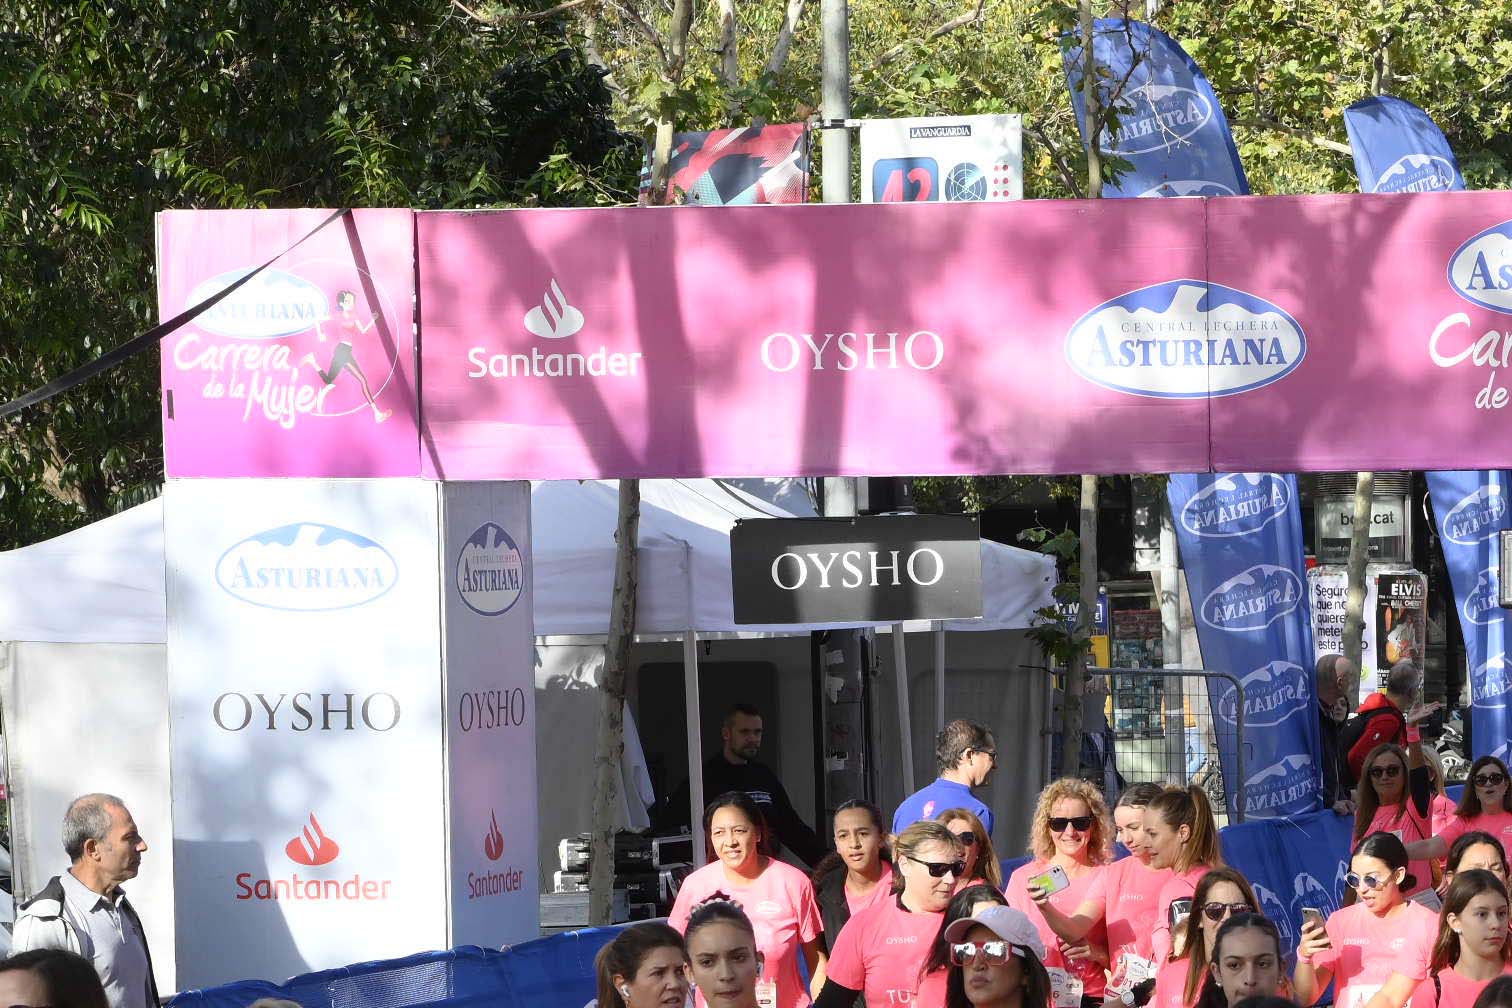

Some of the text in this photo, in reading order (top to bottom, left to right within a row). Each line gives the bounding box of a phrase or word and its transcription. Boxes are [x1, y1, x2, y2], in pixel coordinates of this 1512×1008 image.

[922, 126, 970, 137] VANGUARDIA
[1121, 319, 1280, 334] CENTRAL LECHERA
[174, 332, 292, 371] Carrera
[467, 344, 643, 378] Santander
[760, 331, 945, 373] OYSHO
[1086, 322, 1288, 369] ASTURIANA
[203, 367, 337, 430] de la Mujer
[1474, 370, 1509, 410] de
[231, 555, 385, 589] ASTURIANA
[461, 559, 520, 594] ASTURIANA
[770, 547, 945, 590] OYSHO
[1316, 600, 1332, 613] que
[1391, 583, 1422, 596] ELVIS
[1318, 638, 1336, 650] este
[212, 691, 401, 732] OYSHO
[459, 686, 526, 732] OYSHO
[235, 872, 393, 901] Santander
[467, 868, 524, 900] Santander
